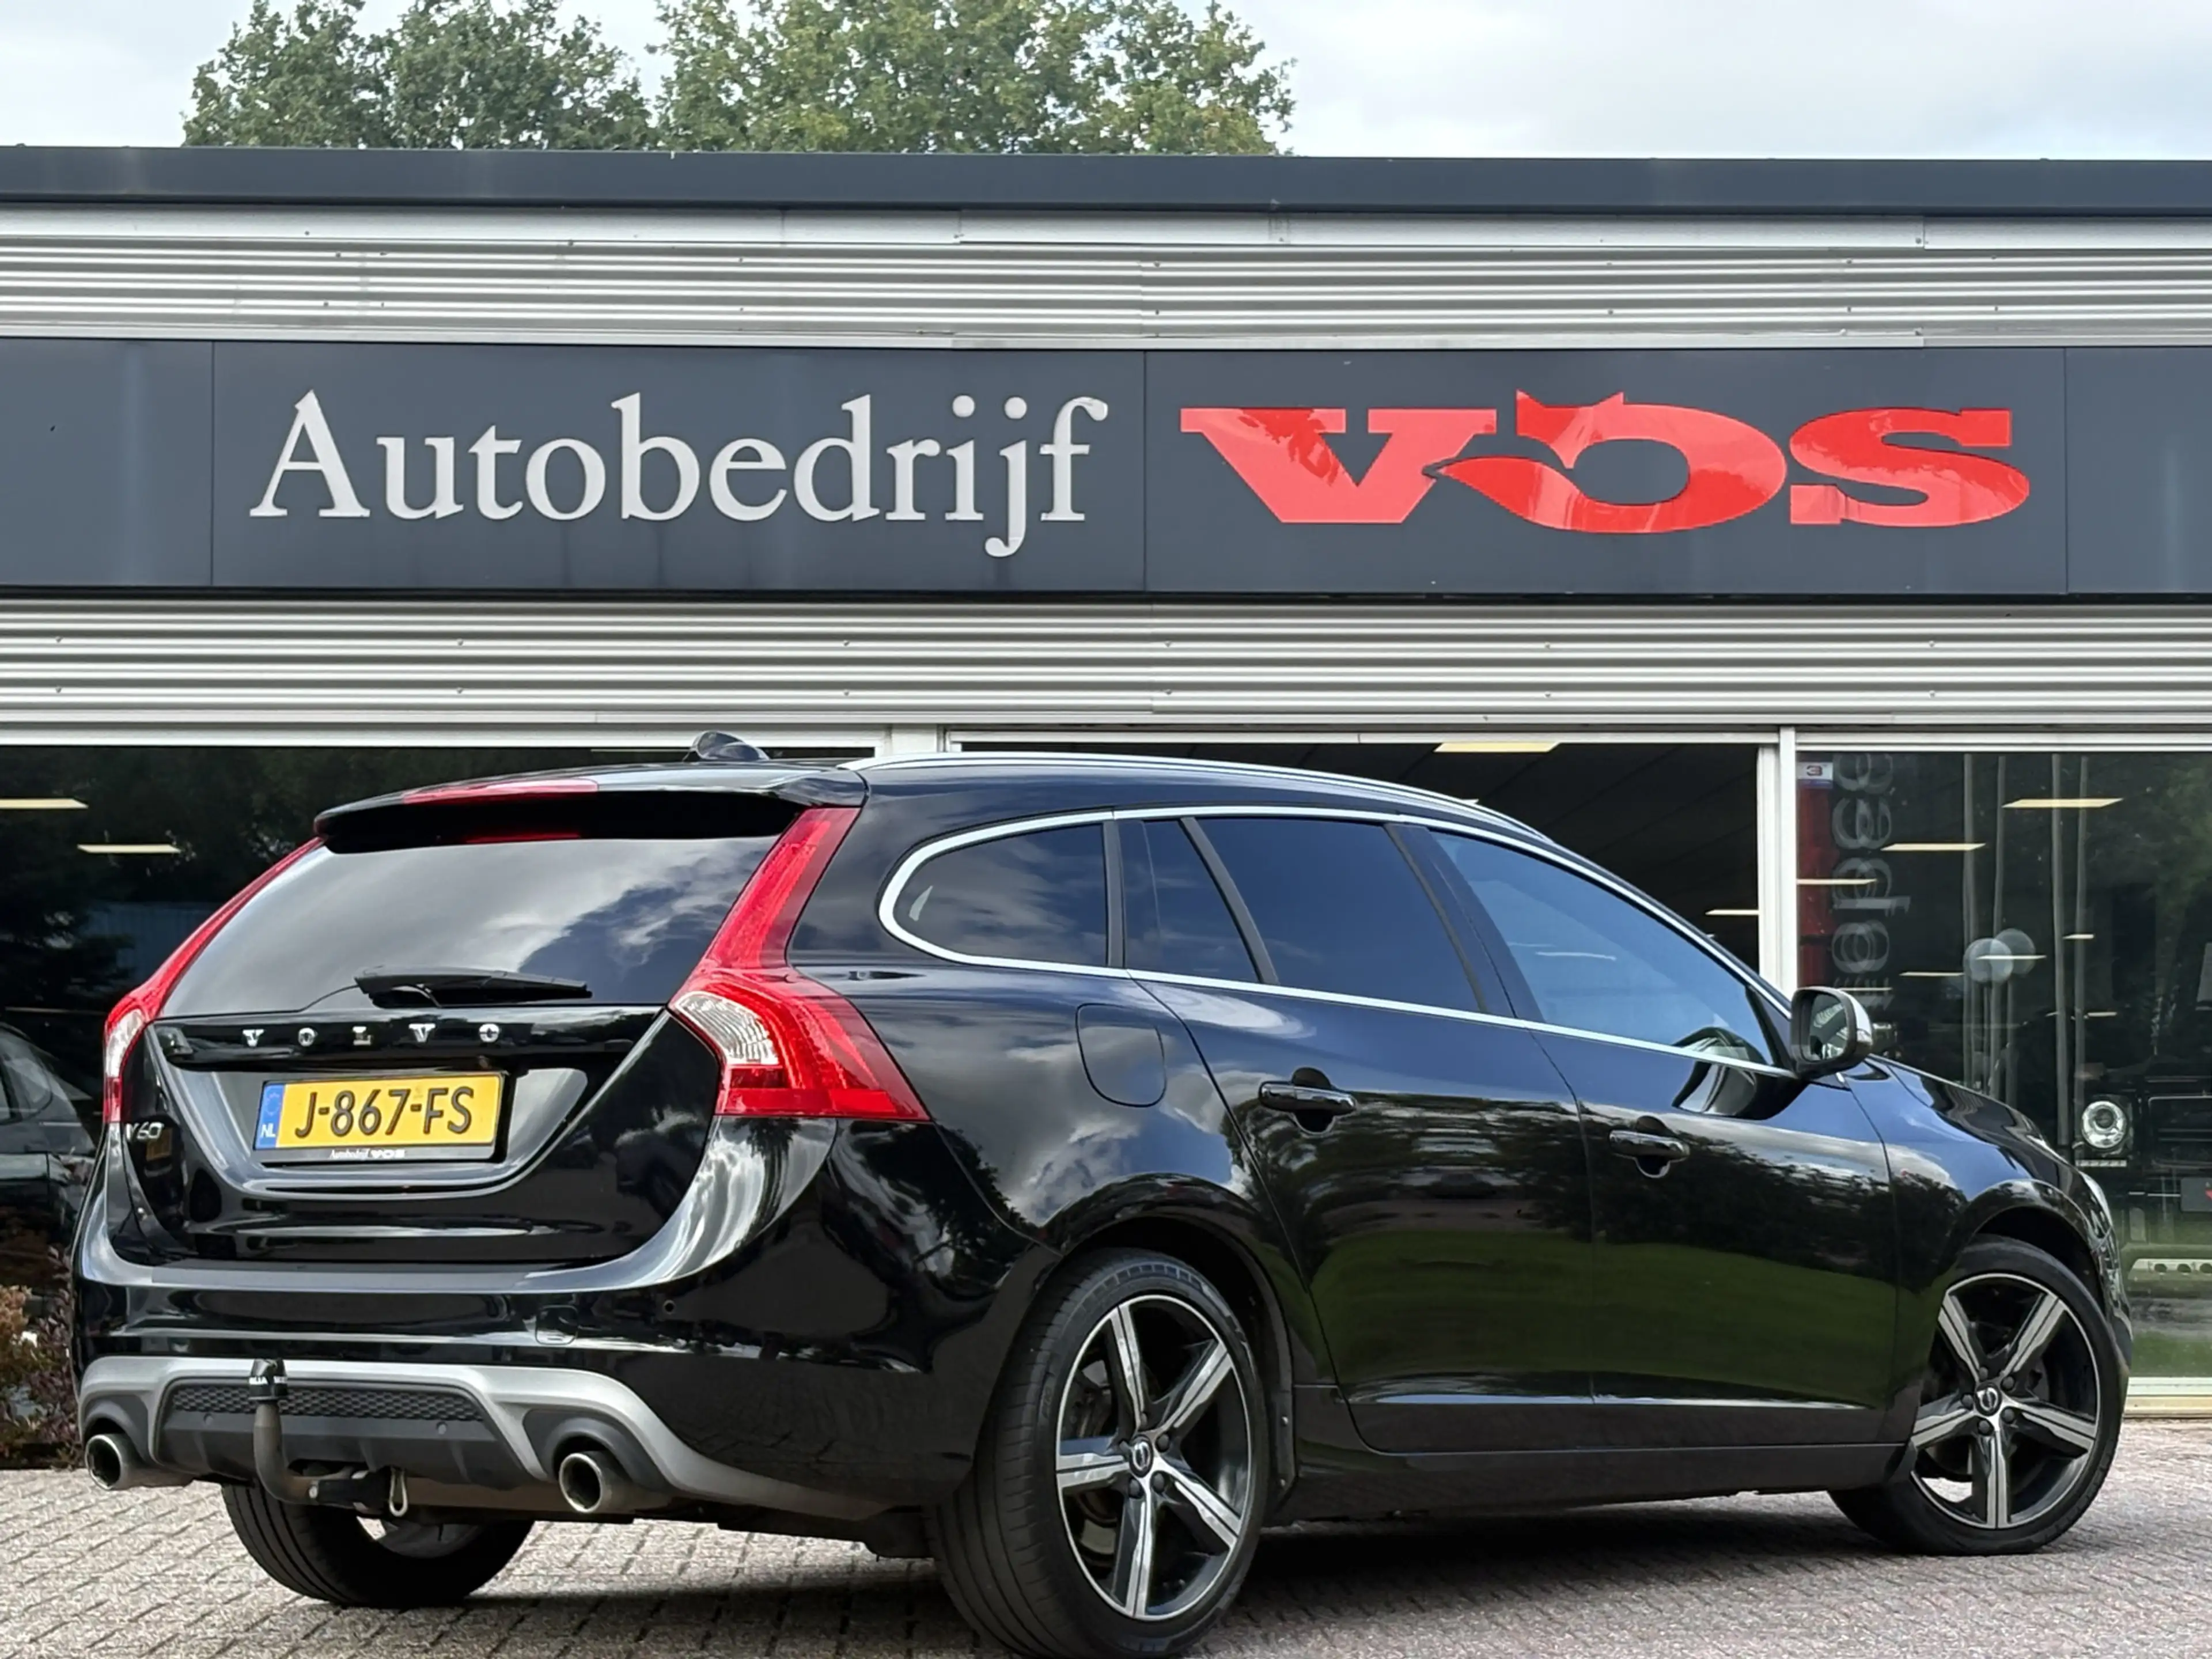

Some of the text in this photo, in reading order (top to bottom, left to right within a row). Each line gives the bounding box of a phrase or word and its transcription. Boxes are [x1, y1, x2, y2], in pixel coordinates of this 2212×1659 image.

[249, 389, 2031, 558] Autobedrijf VOS
[241, 1022, 501, 1047] VOLVO
[126, 1122, 164, 1141] V60
[260, 1086, 475, 1139] NL J-867-FS
